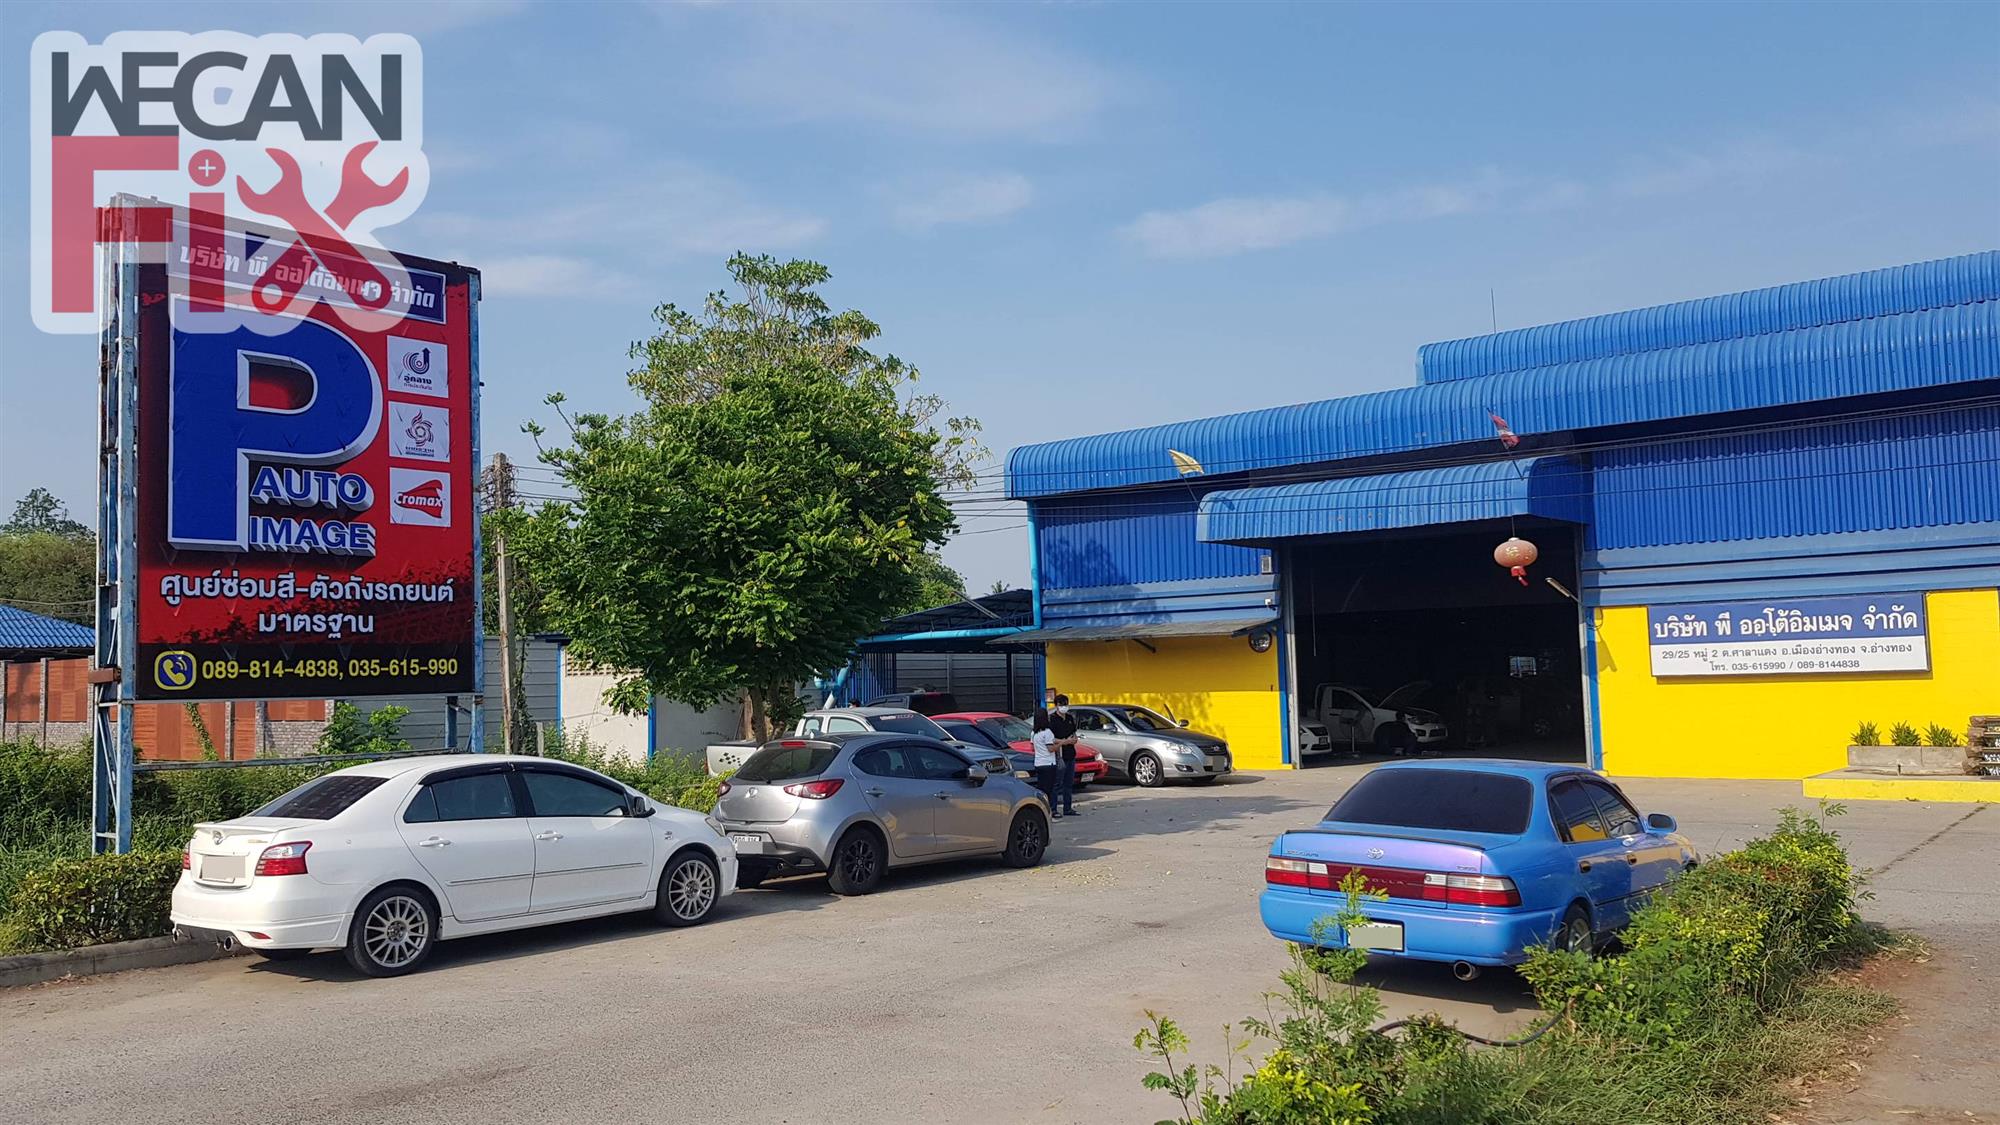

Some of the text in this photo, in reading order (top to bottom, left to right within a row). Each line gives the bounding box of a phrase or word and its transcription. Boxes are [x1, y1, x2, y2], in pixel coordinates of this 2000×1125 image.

[180, 245, 239, 272] บริษัท
[248, 255, 269, 278] พี
[390, 284, 435, 309] จำกัด
[168, 294, 383, 552] P
[251, 466, 374, 512] AUTO
[394, 491, 443, 508] Cromax
[249, 516, 376, 556] IMAGE
[161, 570, 454, 605] ศูนย์ซ่อมสี-ตัวถังรถยนต์
[258, 612, 374, 638] มาตรฐาน
[1654, 605, 1918, 638] บริษัท พี ออโต้อิมเมจ จำกัด
[202, 658, 458, 680] 089-814-4838, 035-615-990
[1662, 650, 1690, 659] 29/25
[1693, 648, 1708, 662] หมู่
[1711, 649, 1718, 658] 2
[1731, 661, 1786, 671] 035-615990
[1797, 660, 1860, 669] 089-8144838
